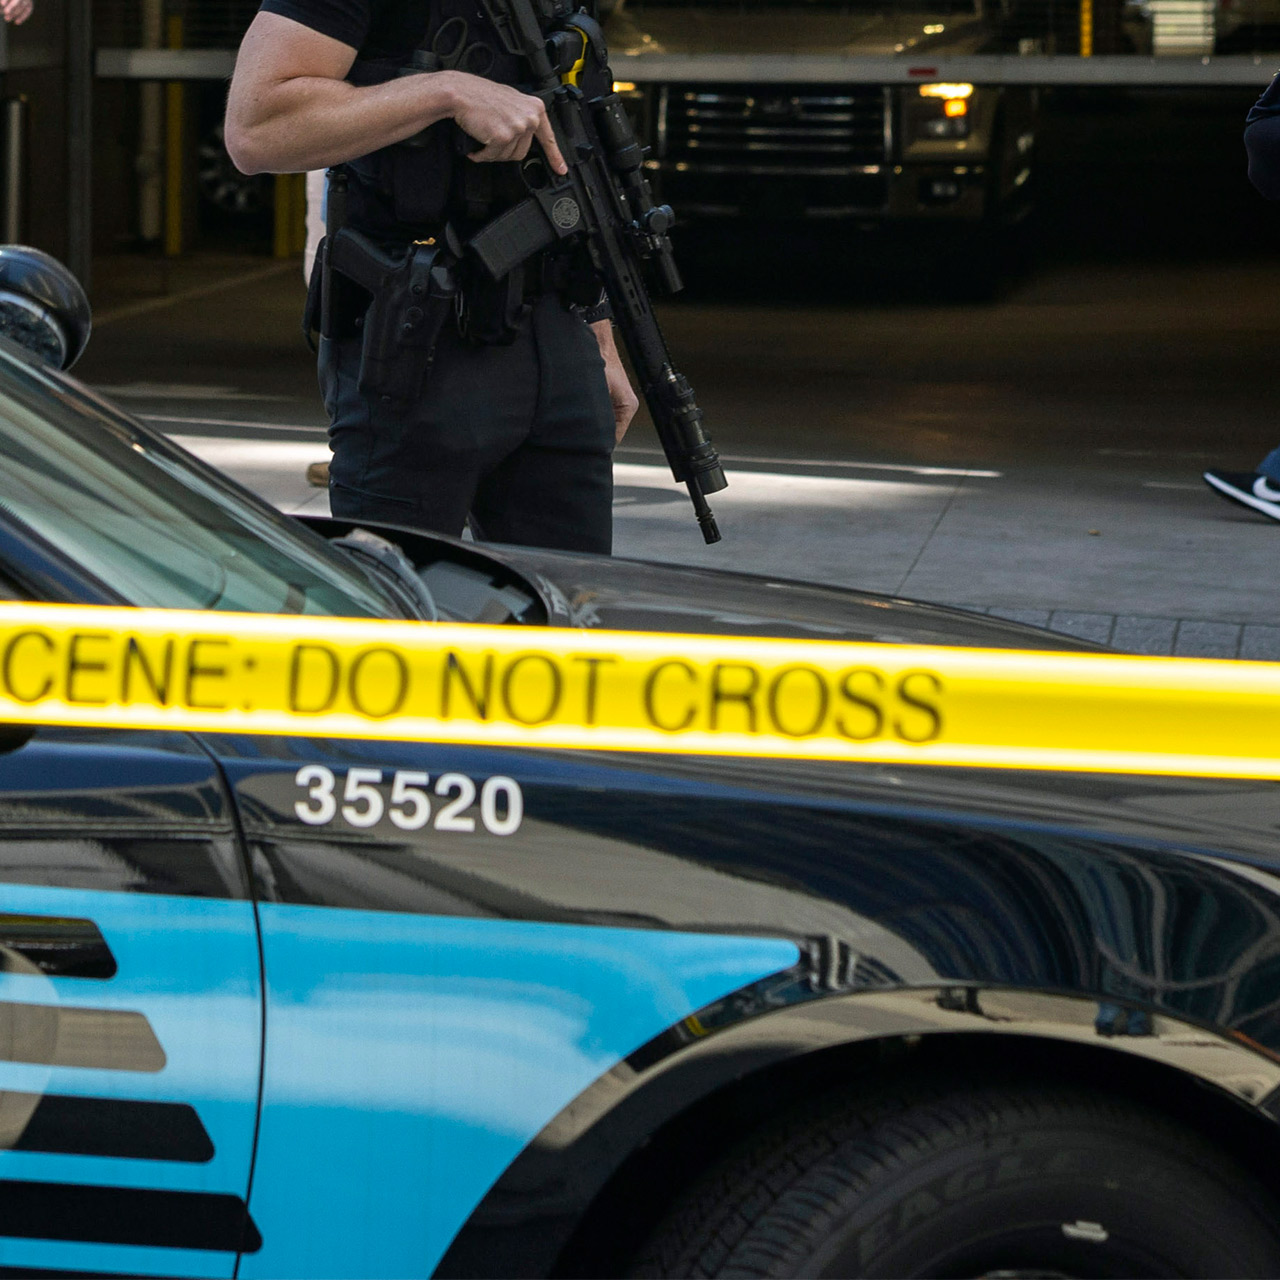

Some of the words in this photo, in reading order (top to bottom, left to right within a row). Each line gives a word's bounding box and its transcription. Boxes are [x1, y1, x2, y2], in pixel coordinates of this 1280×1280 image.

[288, 644, 410, 719] DO
[439, 651, 616, 726] NOT
[644, 660, 944, 743] CROSS
[294, 765, 524, 836] 35520
